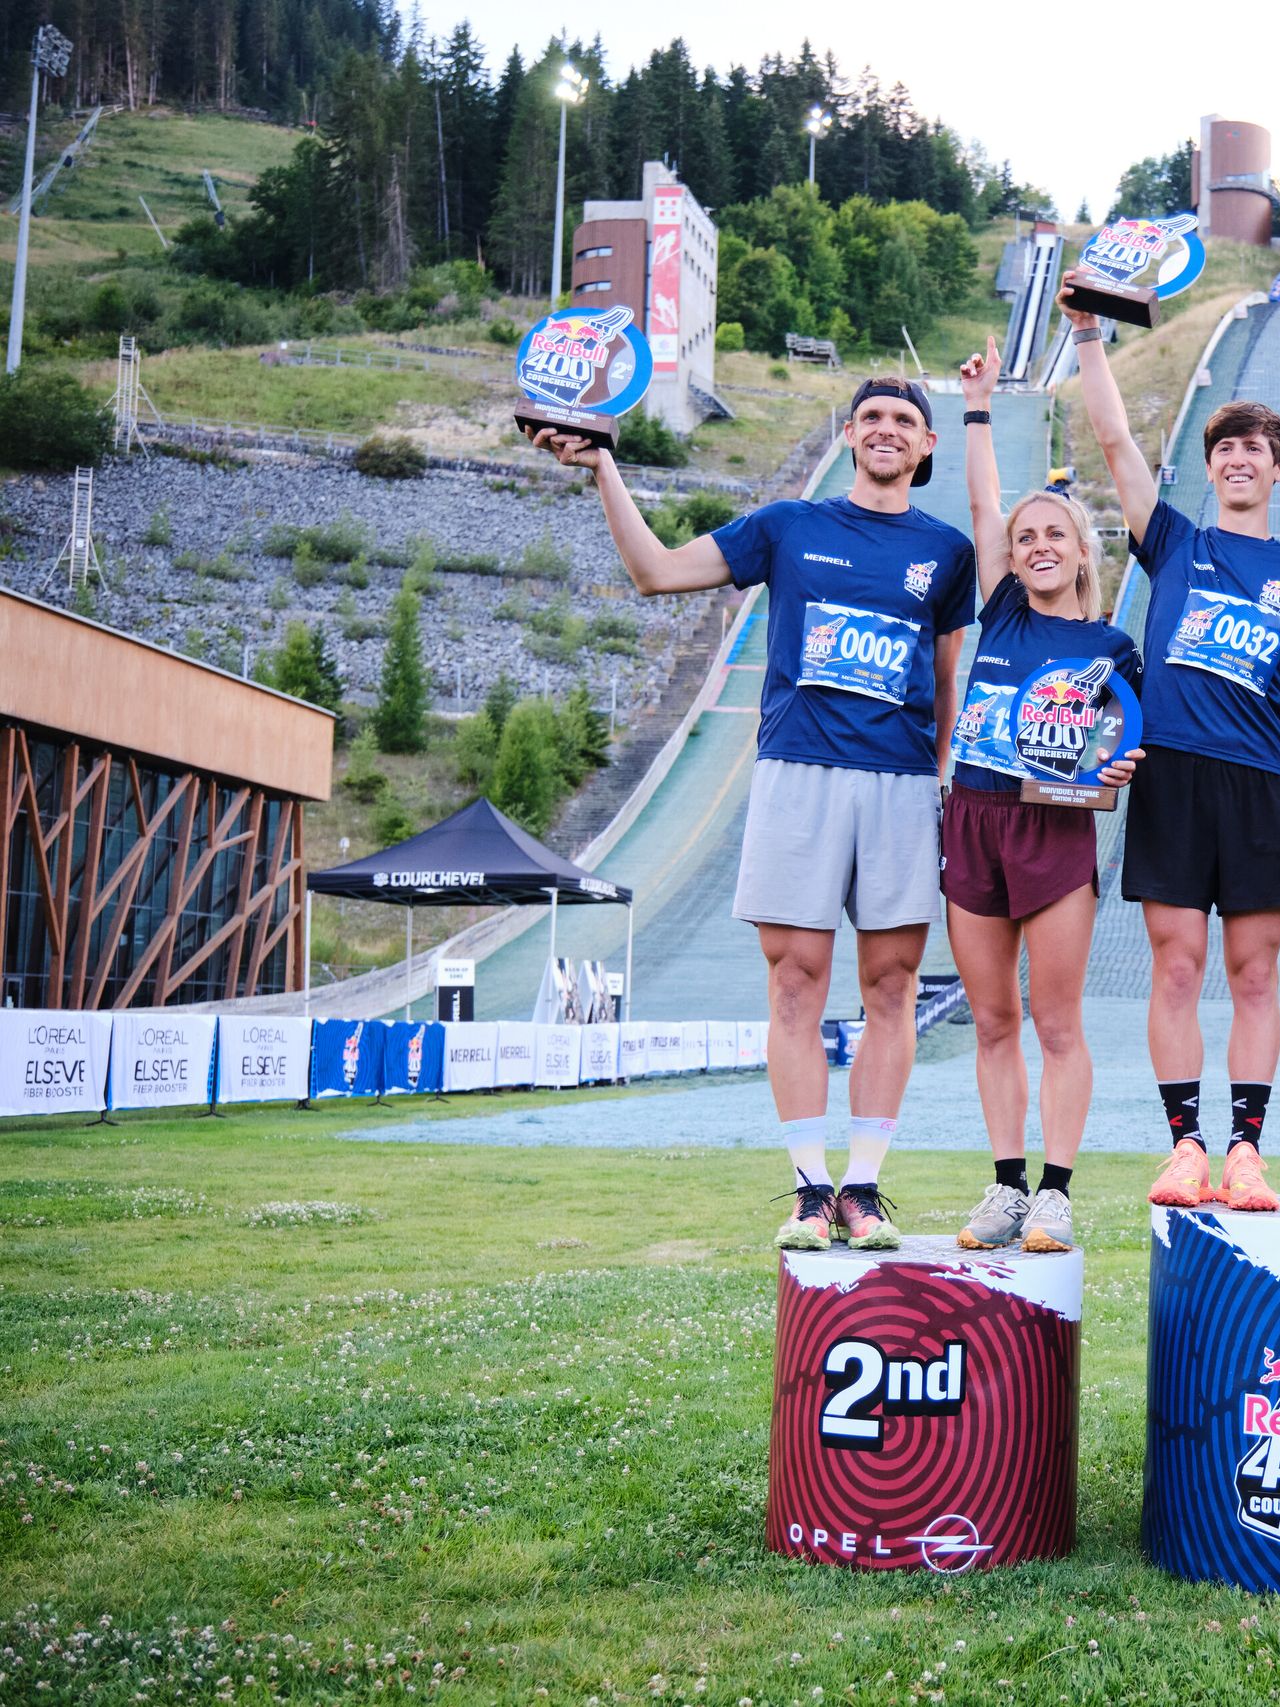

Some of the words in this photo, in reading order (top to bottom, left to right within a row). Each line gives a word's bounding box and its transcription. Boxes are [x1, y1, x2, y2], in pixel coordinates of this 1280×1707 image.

[1100, 228, 1132, 246] Red
[1132, 236, 1163, 252] Bull
[1090, 240, 1148, 266] 400
[1088, 255, 1134, 272] COURCHEVEL
[532, 334, 569, 354] Red
[570, 342, 604, 361] Bull
[525, 351, 590, 382] 400
[526, 372, 582, 390] COURCHEVEL
[572, 410, 596, 420] HOMME
[804, 552, 853, 567] MERRELL
[1179, 625, 1205, 637] 400
[1214, 614, 1279, 665] 0032
[805, 642, 831, 654] 400
[840, 628, 908, 672] 0002
[976, 656, 1010, 666] ERRELL
[842, 674, 868, 685] MERRELL
[1022, 704, 1057, 724] Red
[1060, 708, 1094, 727] Bull
[956, 720, 981, 732] 400
[1103, 716, 1122, 737] 2e
[1020, 721, 1084, 750] 400
[1022, 747, 1078, 760] COURCHEVEL
[1039, 786, 1074, 796] INDIVIDUEL
[1076, 789, 1099, 798] FEMME
[390, 871, 487, 887] COURCHEVEL
[450, 1049, 491, 1063] MERRELL
[500, 1046, 530, 1059] MERRELL
[25, 1060, 85, 1084] ELSEVE
[134, 1060, 188, 1081] ELSEVE
[242, 1056, 286, 1076] ELSEVE
[24, 1087, 43, 1098] FIBER
[45, 1086, 83, 1098] BOOSTE
[154, 1083, 187, 1093] BOOSTER
[822, 1341, 962, 1438] 2nd
[789, 1523, 891, 1554] OPEL
